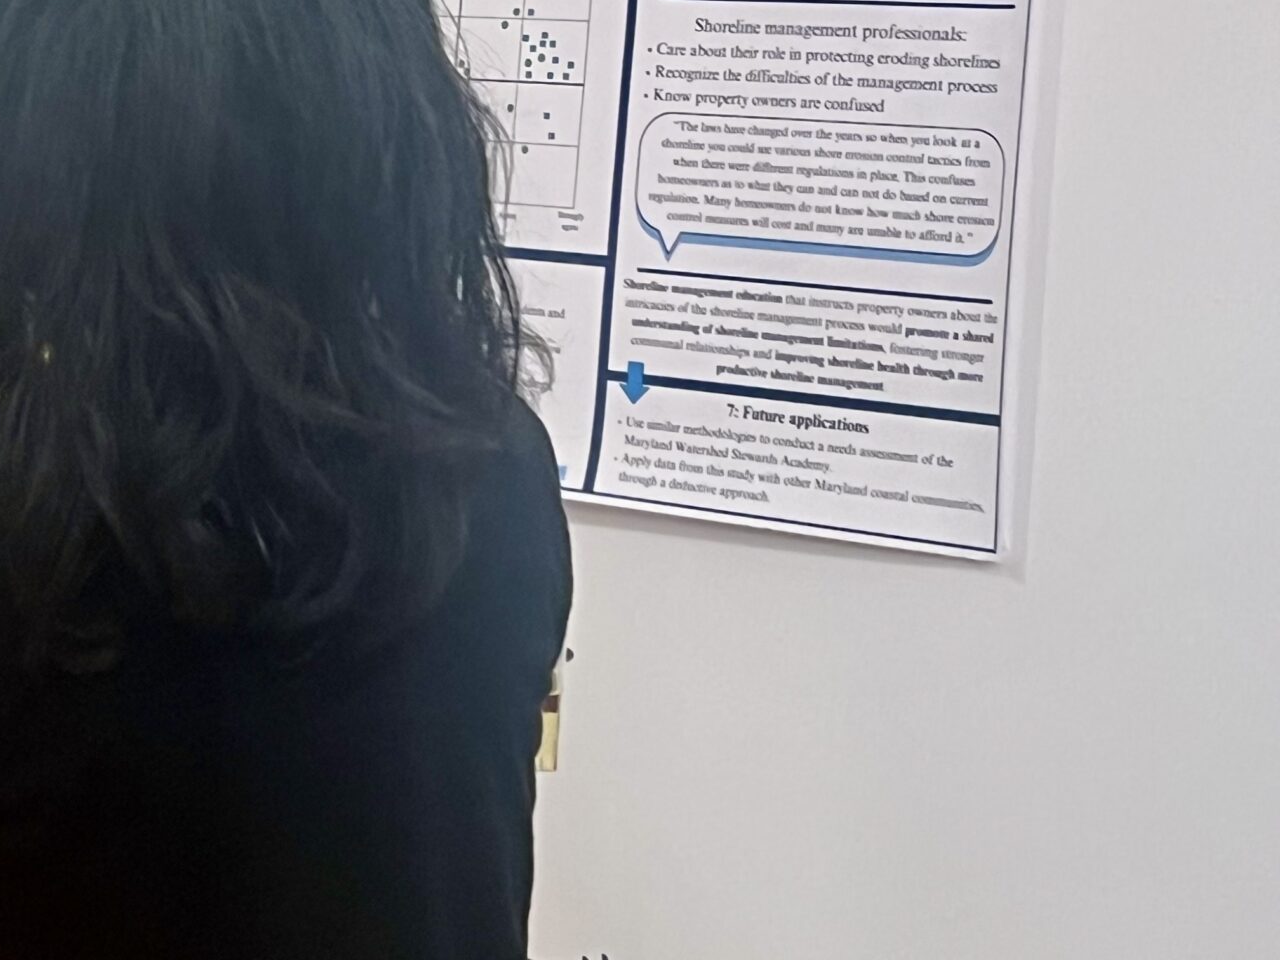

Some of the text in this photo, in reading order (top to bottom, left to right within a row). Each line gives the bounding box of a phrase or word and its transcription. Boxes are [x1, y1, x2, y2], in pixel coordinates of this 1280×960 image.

[695, 18, 760, 34] Shoreline
[764, 25, 858, 39] management
[657, 42, 929, 69] Care about their role in protecting eroding
[656, 65, 997, 94] Recognize the difficulties of the management process
[654, 89, 884, 112] Know property owners are confused
[727, 404, 869, 434] 7: Future applications
[625, 435, 672, 450] Maryland
[626, 416, 644, 428] Use
[921, 455, 935, 465] of
[937, 456, 953, 467] the
